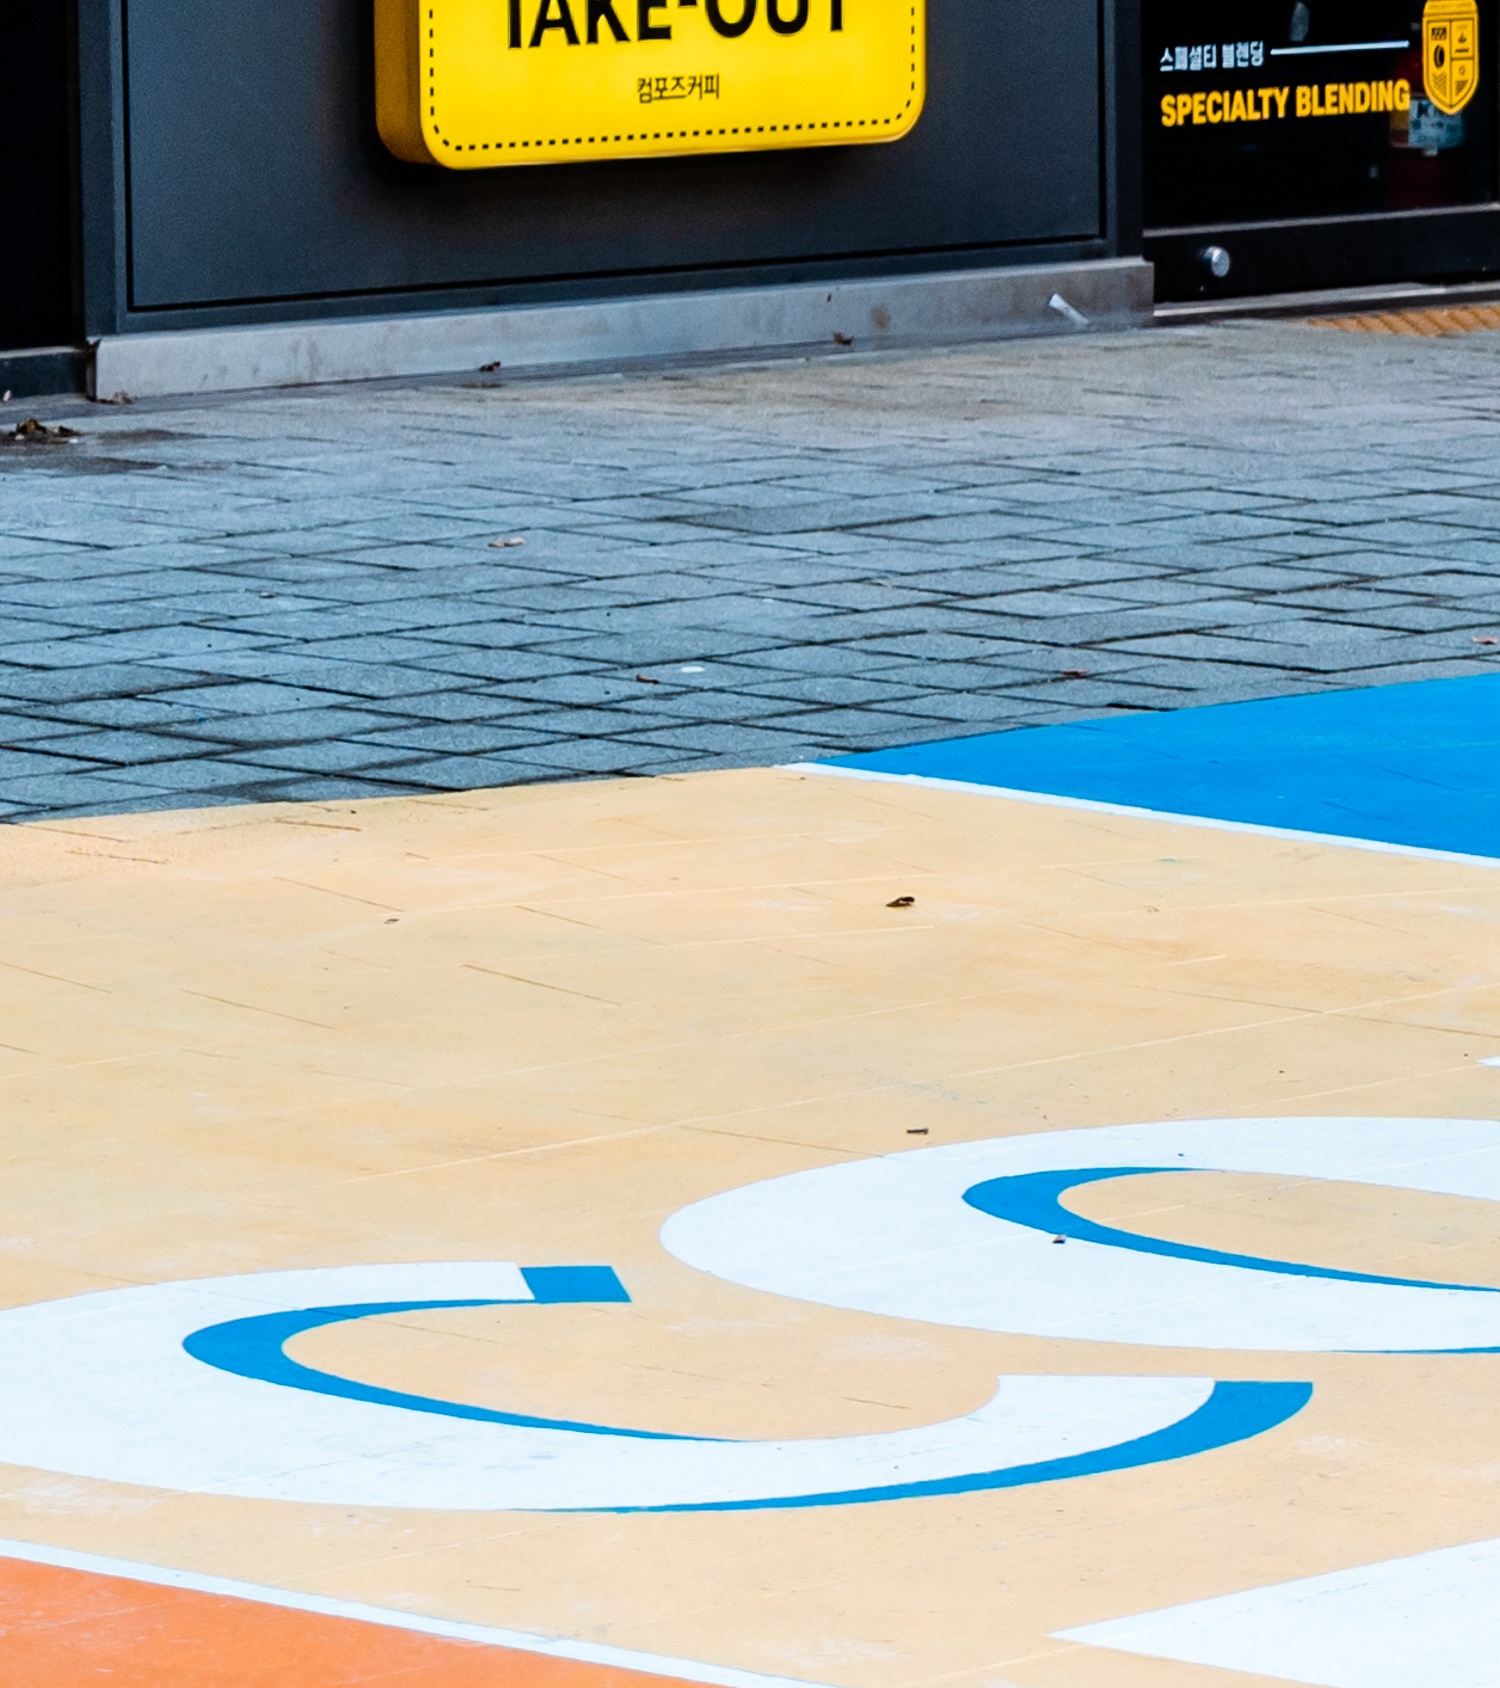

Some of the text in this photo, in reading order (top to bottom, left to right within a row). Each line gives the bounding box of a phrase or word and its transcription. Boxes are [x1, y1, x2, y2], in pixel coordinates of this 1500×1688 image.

[1159, 40, 1264, 72] 스페셜티 블렌딩
[637, 73, 720, 104] 컴포즈커피
[1160, 78, 1410, 127] SPECIALTY BLENDING
